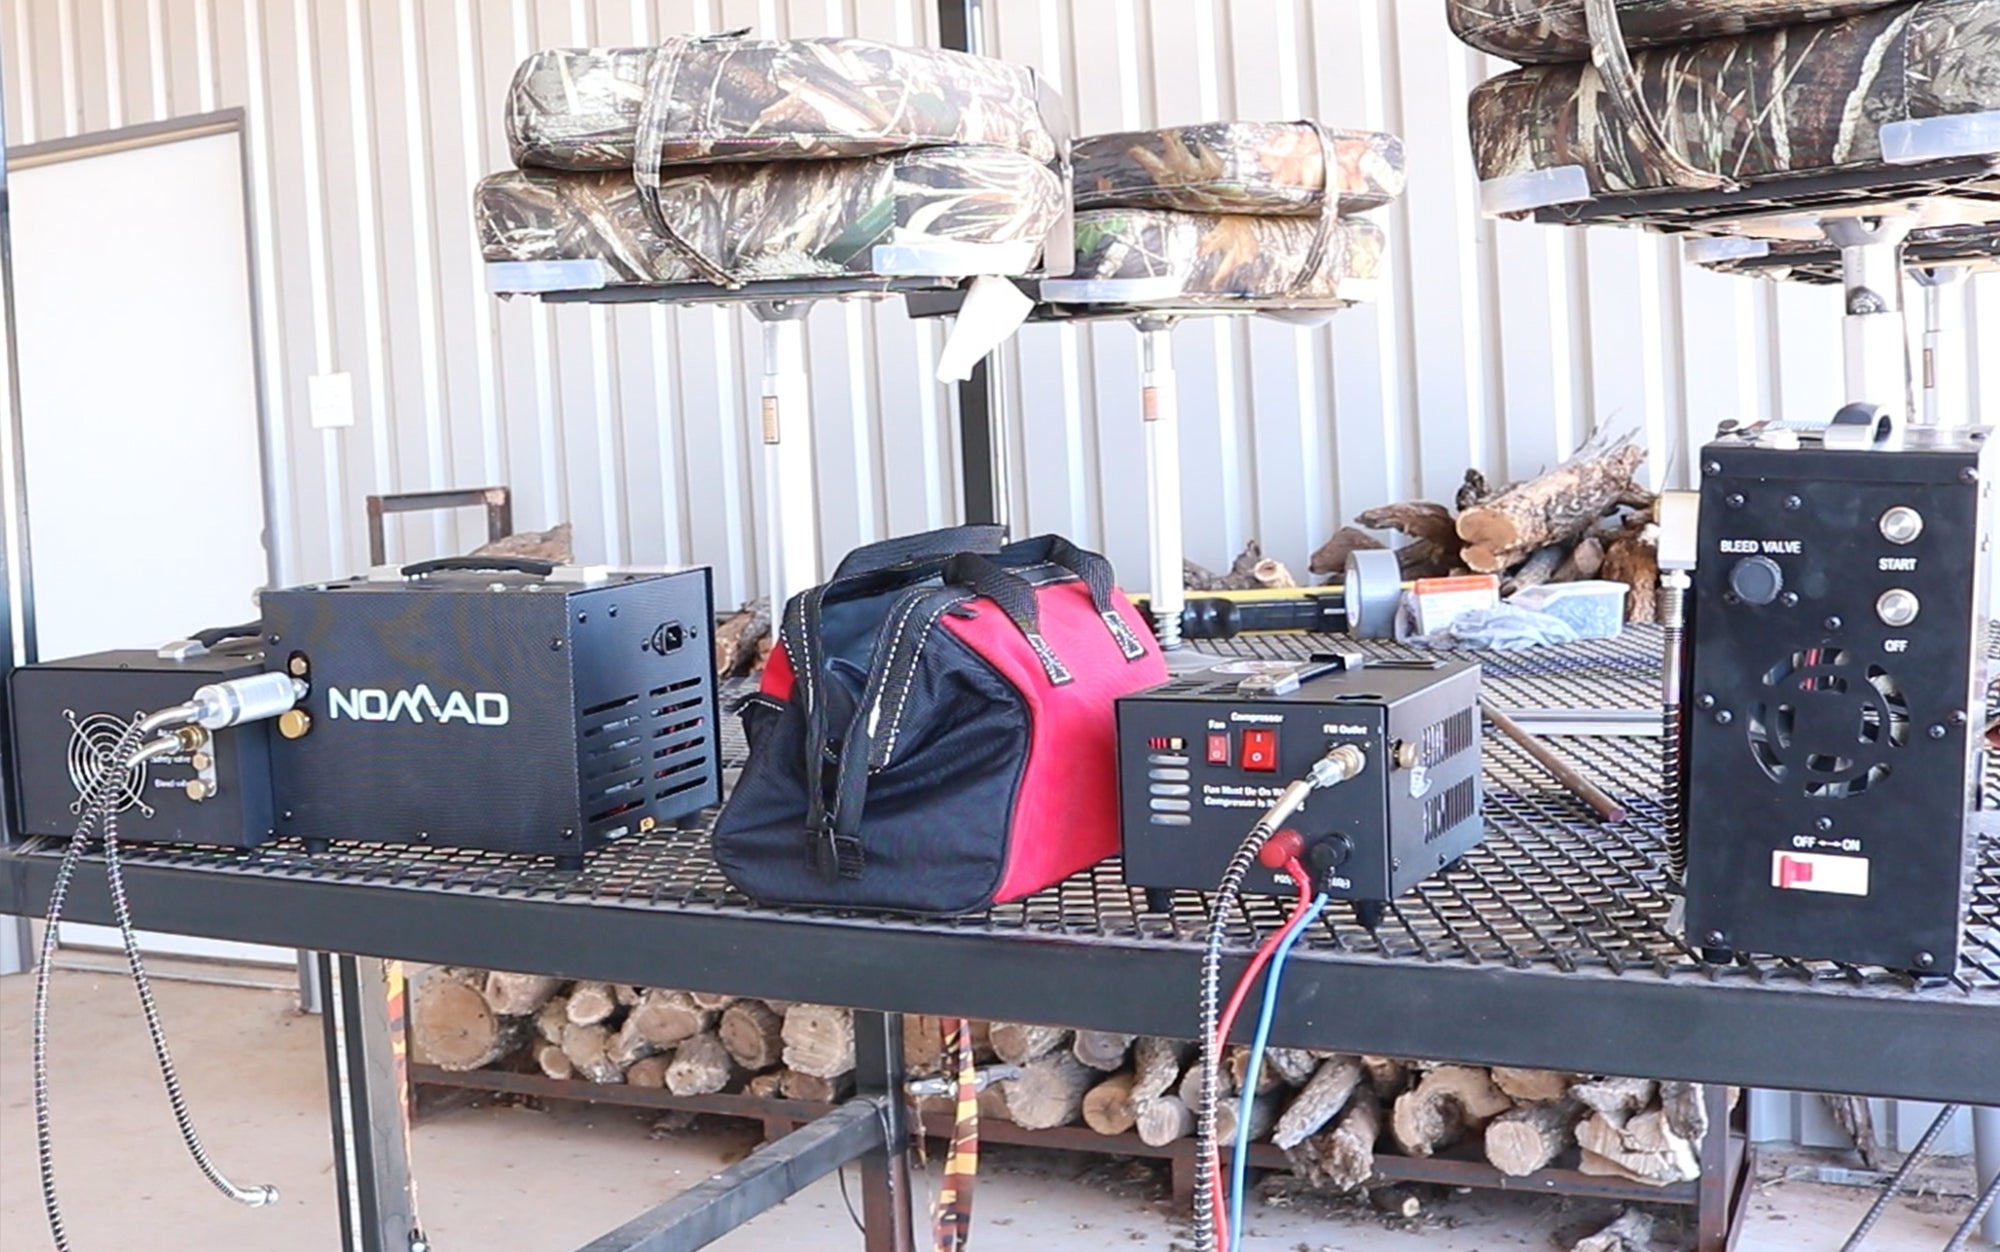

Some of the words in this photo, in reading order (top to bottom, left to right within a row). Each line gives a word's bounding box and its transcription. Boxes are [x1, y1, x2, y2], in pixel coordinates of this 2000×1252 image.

[1720, 540, 1759, 553] BLEED
[1762, 541, 1802, 554] VALVE
[1879, 558, 1917, 571] START
[1884, 640, 1908, 653] OFF
[328, 684, 509, 726] NOMAD
[1208, 719, 1226, 729] Fan
[1231, 712, 1284, 723] Compressor
[1793, 835, 1816, 848] OFF
[1842, 839, 1861, 852] ON
